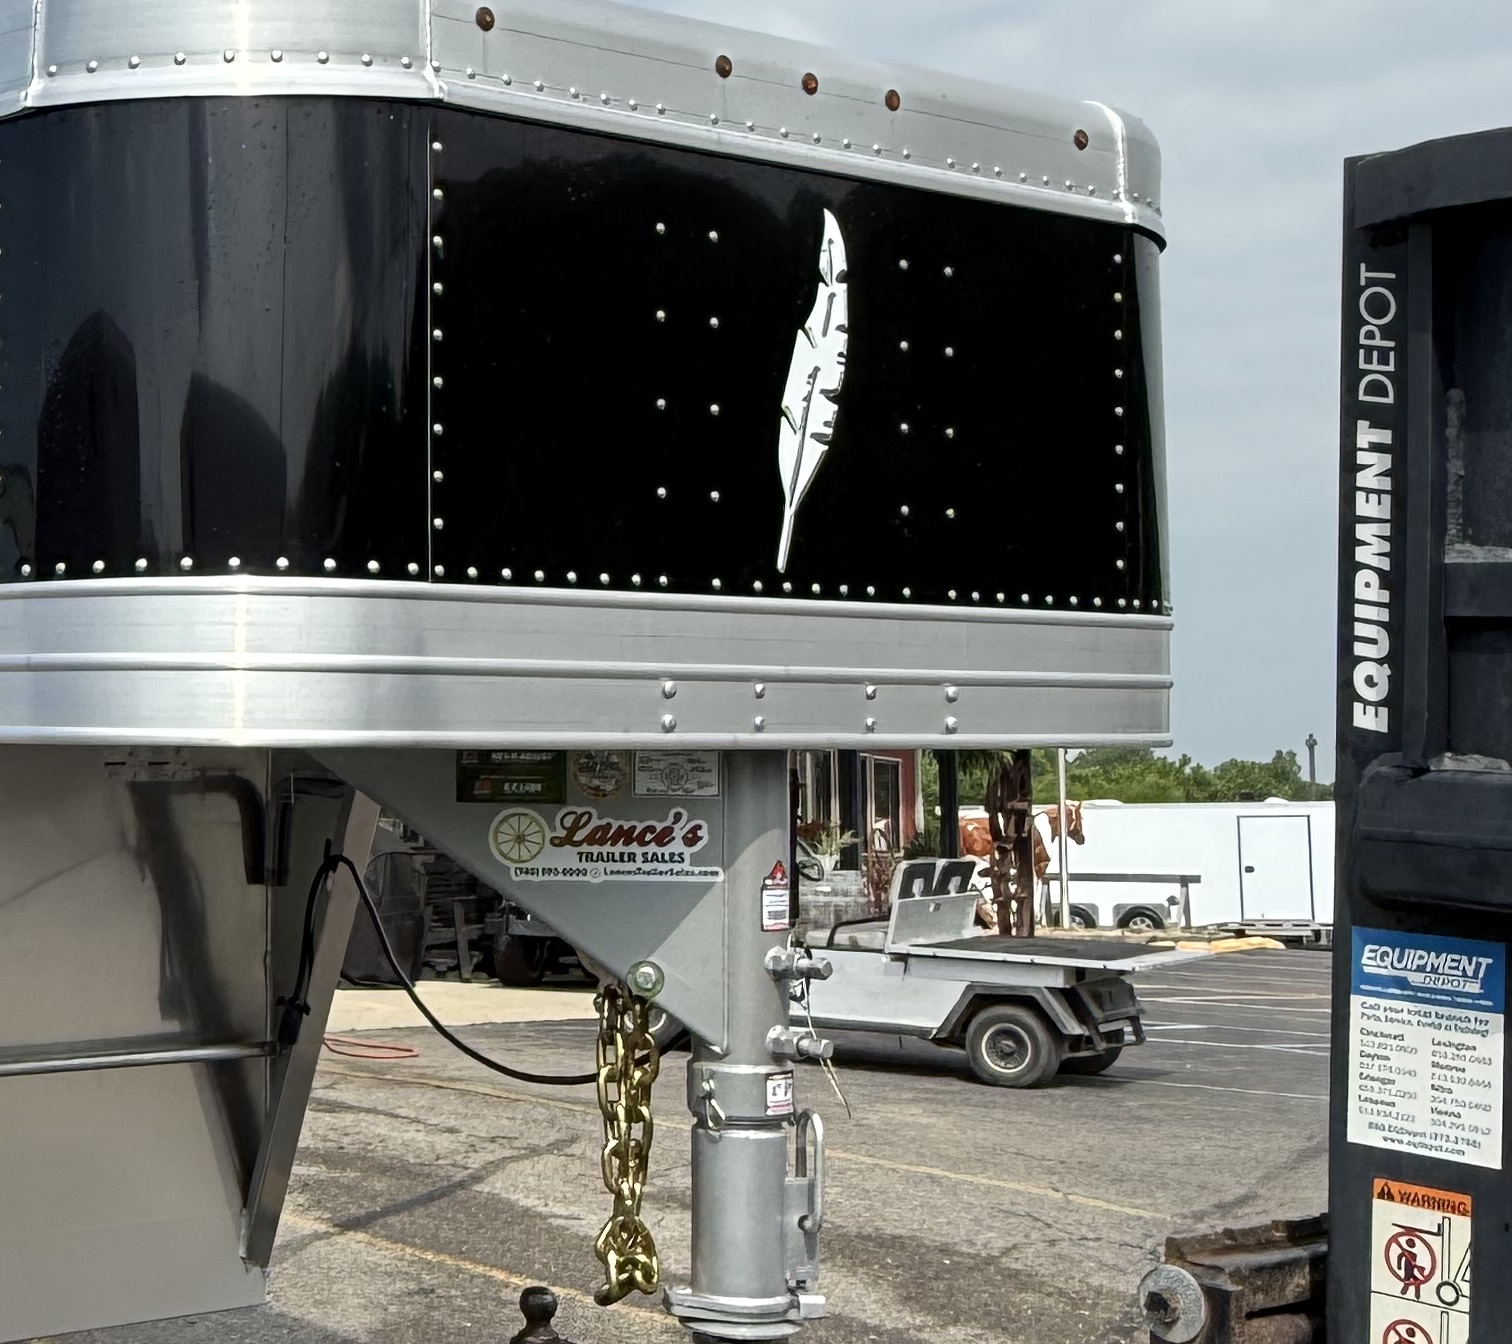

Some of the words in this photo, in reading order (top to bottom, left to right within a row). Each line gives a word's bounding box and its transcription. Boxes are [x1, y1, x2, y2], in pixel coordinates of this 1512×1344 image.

[1358, 261, 1398, 404] DEPOT
[1352, 419, 1393, 734] EQUIPMENT
[549, 809, 704, 847] Lance's
[577, 851, 637, 863] TRAILER
[641, 851, 686, 863] SALES
[1361, 944, 1493, 979] EQUIPMENT
[1398, 1189, 1470, 1217] WARNING
